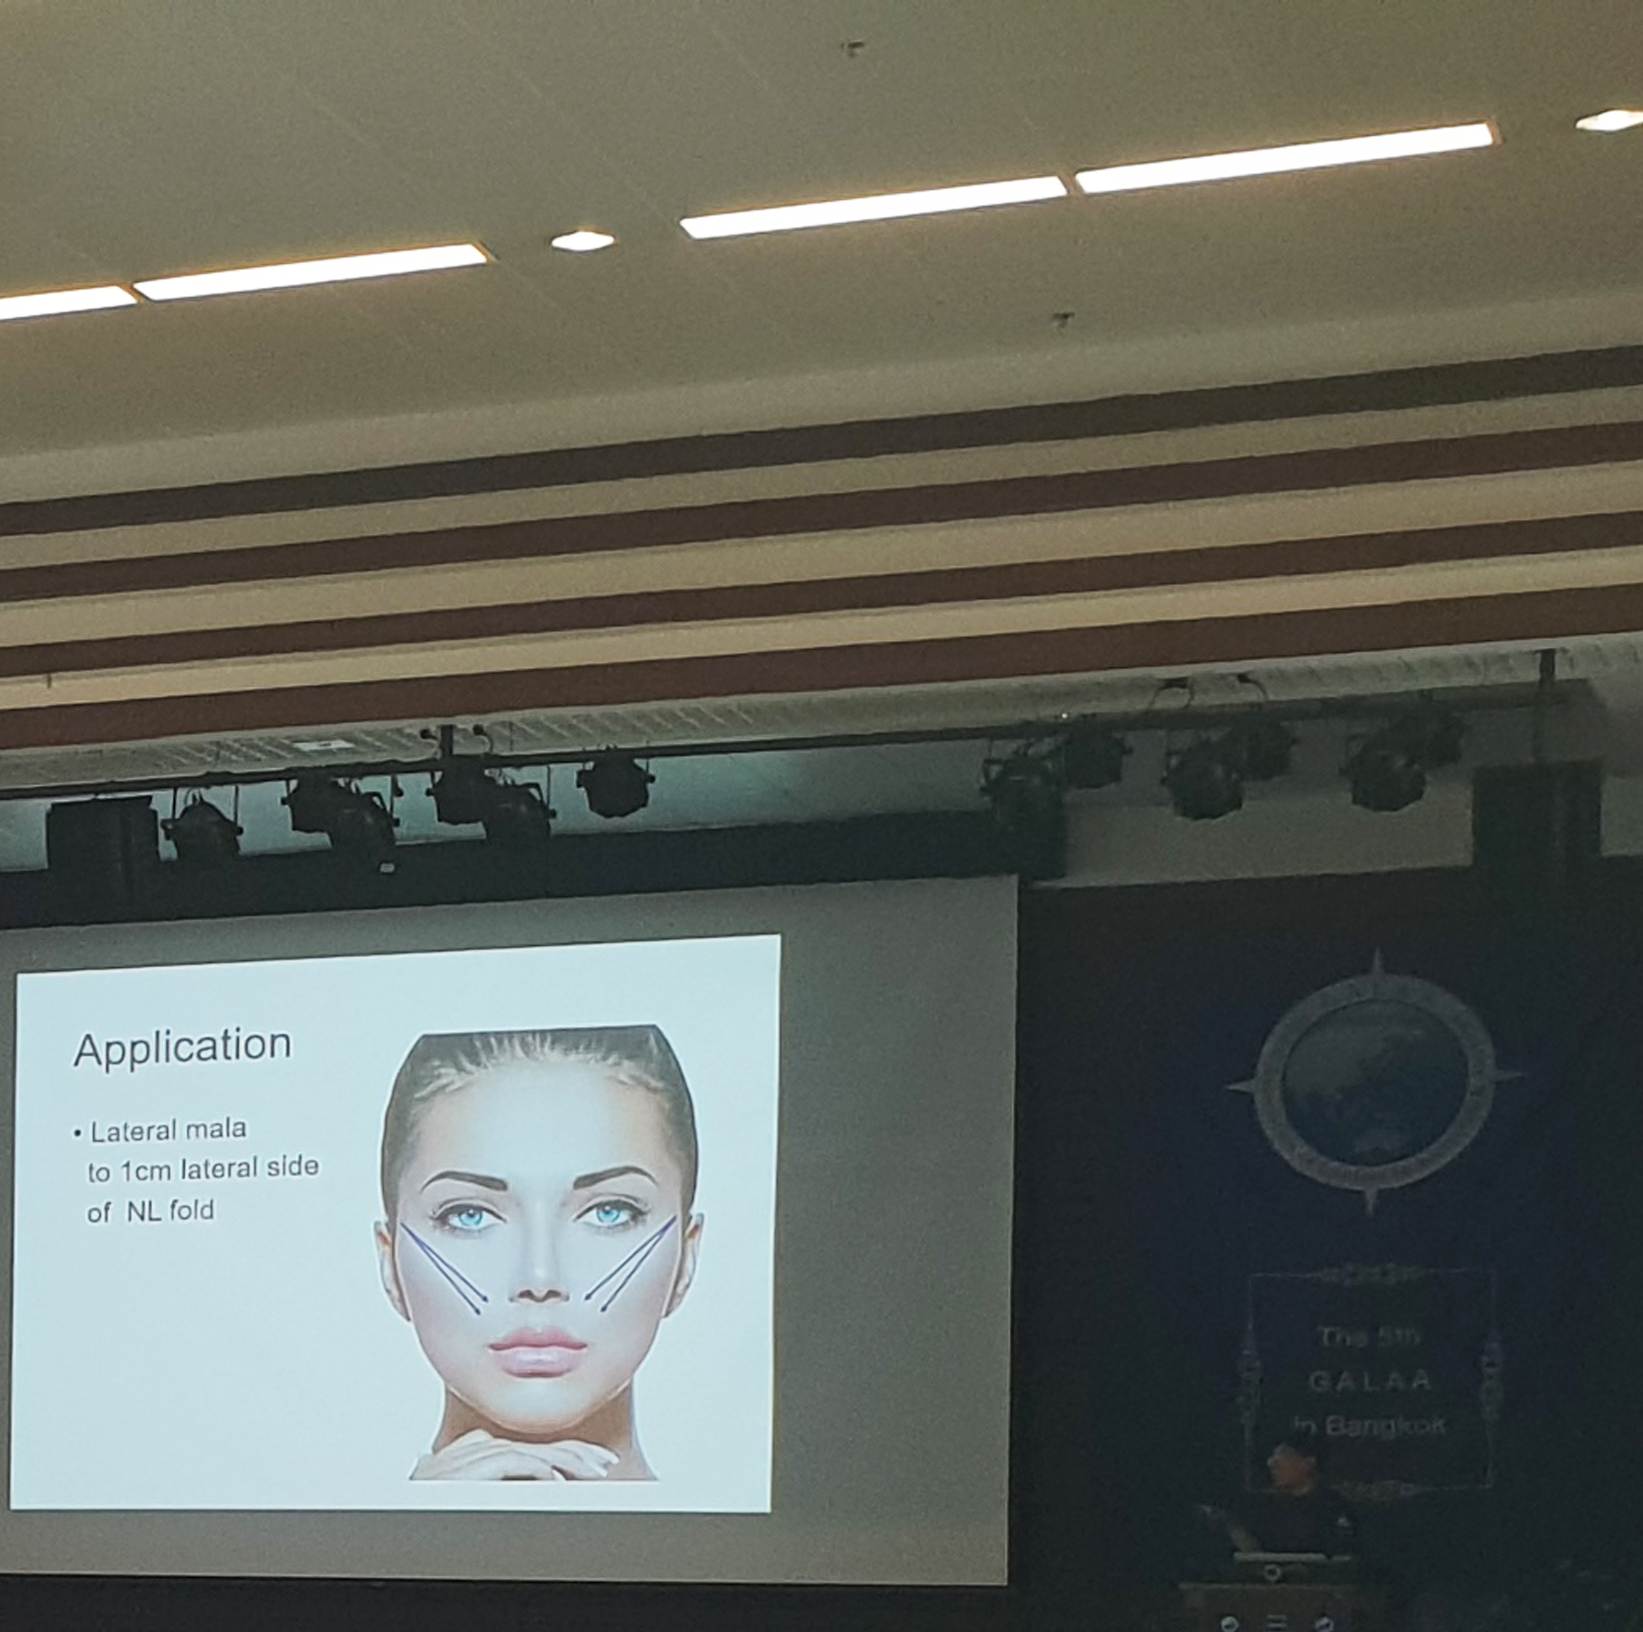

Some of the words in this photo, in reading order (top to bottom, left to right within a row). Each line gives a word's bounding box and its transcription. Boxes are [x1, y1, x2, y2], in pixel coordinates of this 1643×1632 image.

[73, 1027, 292, 1074] Application
[91, 1118, 177, 1143] Lateral
[186, 1116, 247, 1140] mala
[88, 1162, 110, 1183] to
[121, 1160, 171, 1182] 1cm
[181, 1155, 258, 1180] lateral
[267, 1154, 320, 1177] side
[87, 1201, 112, 1223] of
[127, 1200, 162, 1222] NL
[170, 1198, 215, 1221] fold
[1309, 1369, 1433, 1393] GALAA
[1325, 1414, 1448, 1441] Bangkok
